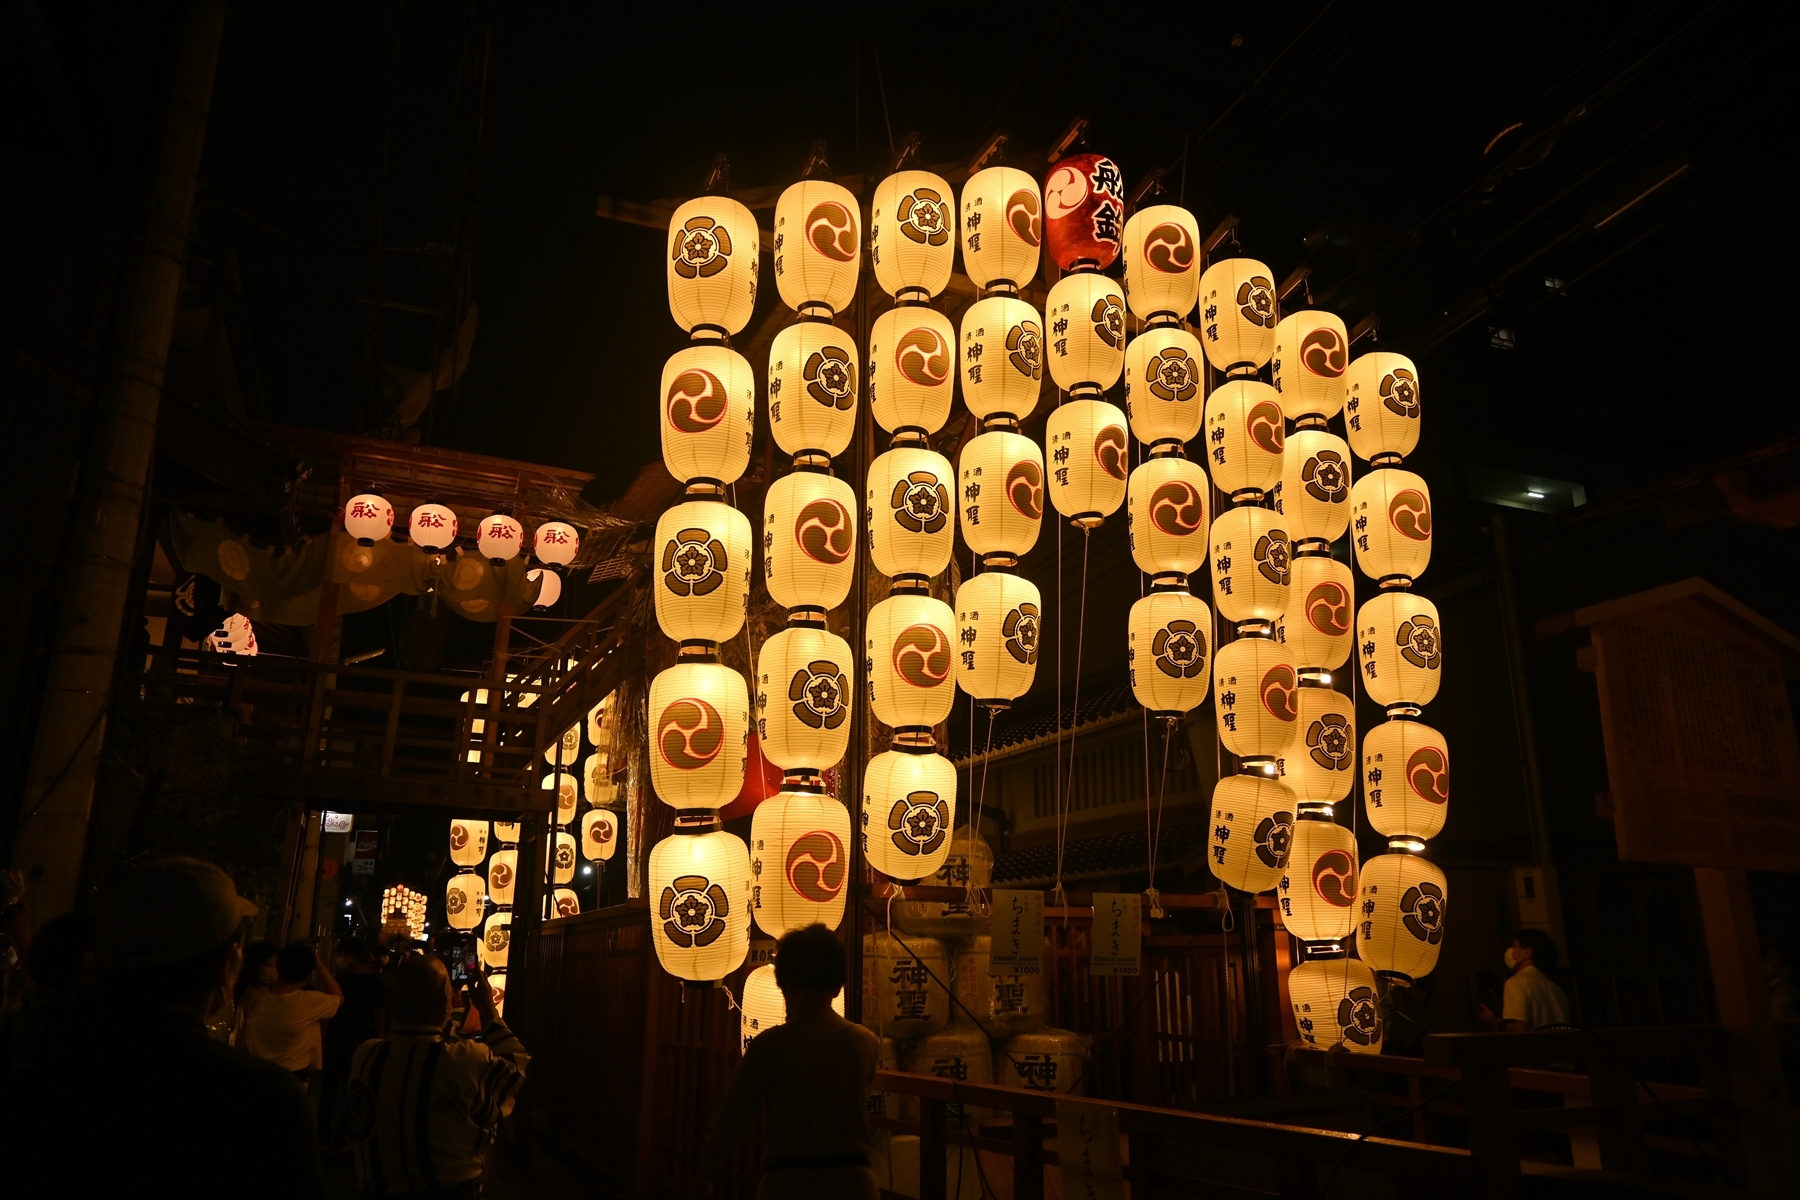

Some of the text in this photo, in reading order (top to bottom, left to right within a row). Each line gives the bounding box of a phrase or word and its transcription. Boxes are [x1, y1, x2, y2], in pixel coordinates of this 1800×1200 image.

[966, 211, 982, 253] 神聖
[1052, 317, 1069, 357] 神聖
[1204, 304, 1219, 342] 神聖
[966, 342, 984, 384] 神聖
[770, 377, 782, 423] 神聖
[1347, 396, 1361, 432] 神聖
[1052, 445, 1069, 486] 神聖
[1211, 426, 1226, 465] 神聖
[964, 482, 981, 526] 神聖
[1355, 515, 1369, 552] 神聖
[1216, 555, 1233, 595] 神聖
[960, 626, 977, 670] 神聖
[1362, 640, 1377, 679] 神聖
[1220, 690, 1237, 731] 神聖
[1367, 767, 1382, 808] 神聖
[1213, 824, 1230, 865] 神聖
[1011, 896, 1023, 955] ちまき
[1111, 899, 1122, 956] ちまき
[1361, 899, 1375, 940] 神聖
[889, 960, 931, 1021] 神聖
[1014, 966, 1040, 974] ¥1000
[1017, 1054, 1058, 1091] 神
